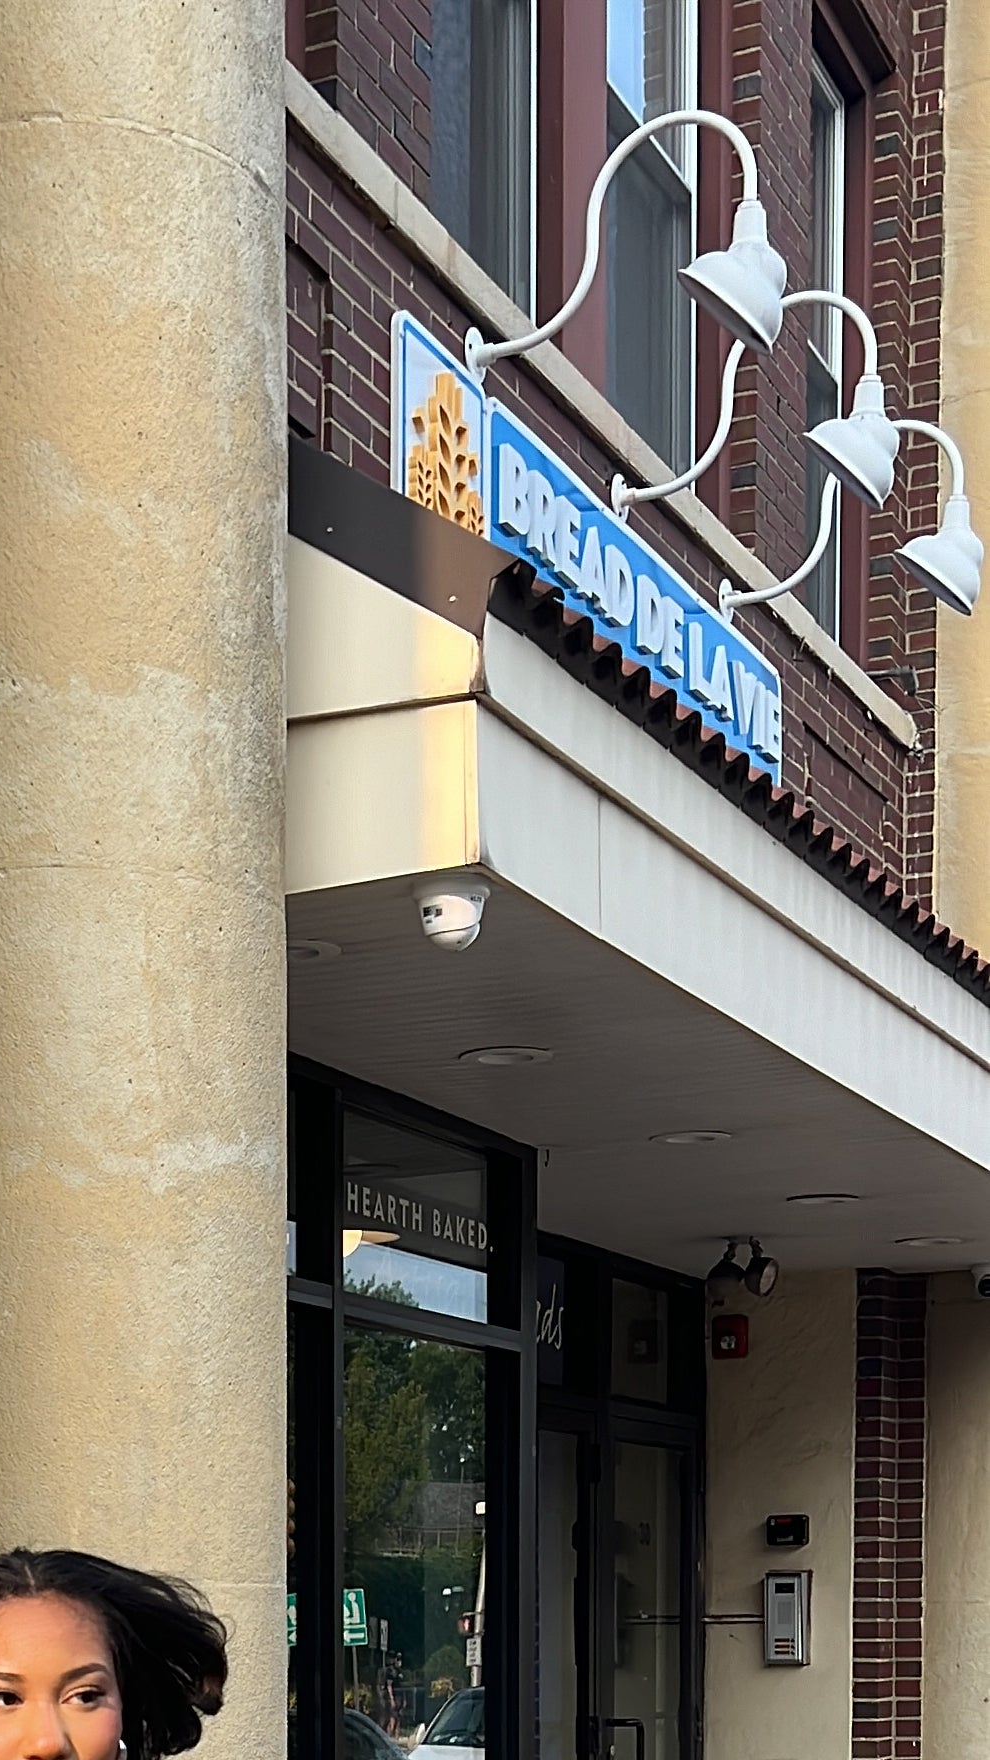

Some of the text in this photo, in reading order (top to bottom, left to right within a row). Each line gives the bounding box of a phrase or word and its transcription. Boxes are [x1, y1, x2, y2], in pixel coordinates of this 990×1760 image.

[496, 443, 779, 764] BREAD DE LA VIE
[347, 1181, 493, 1252] HEARTH BAKED.
